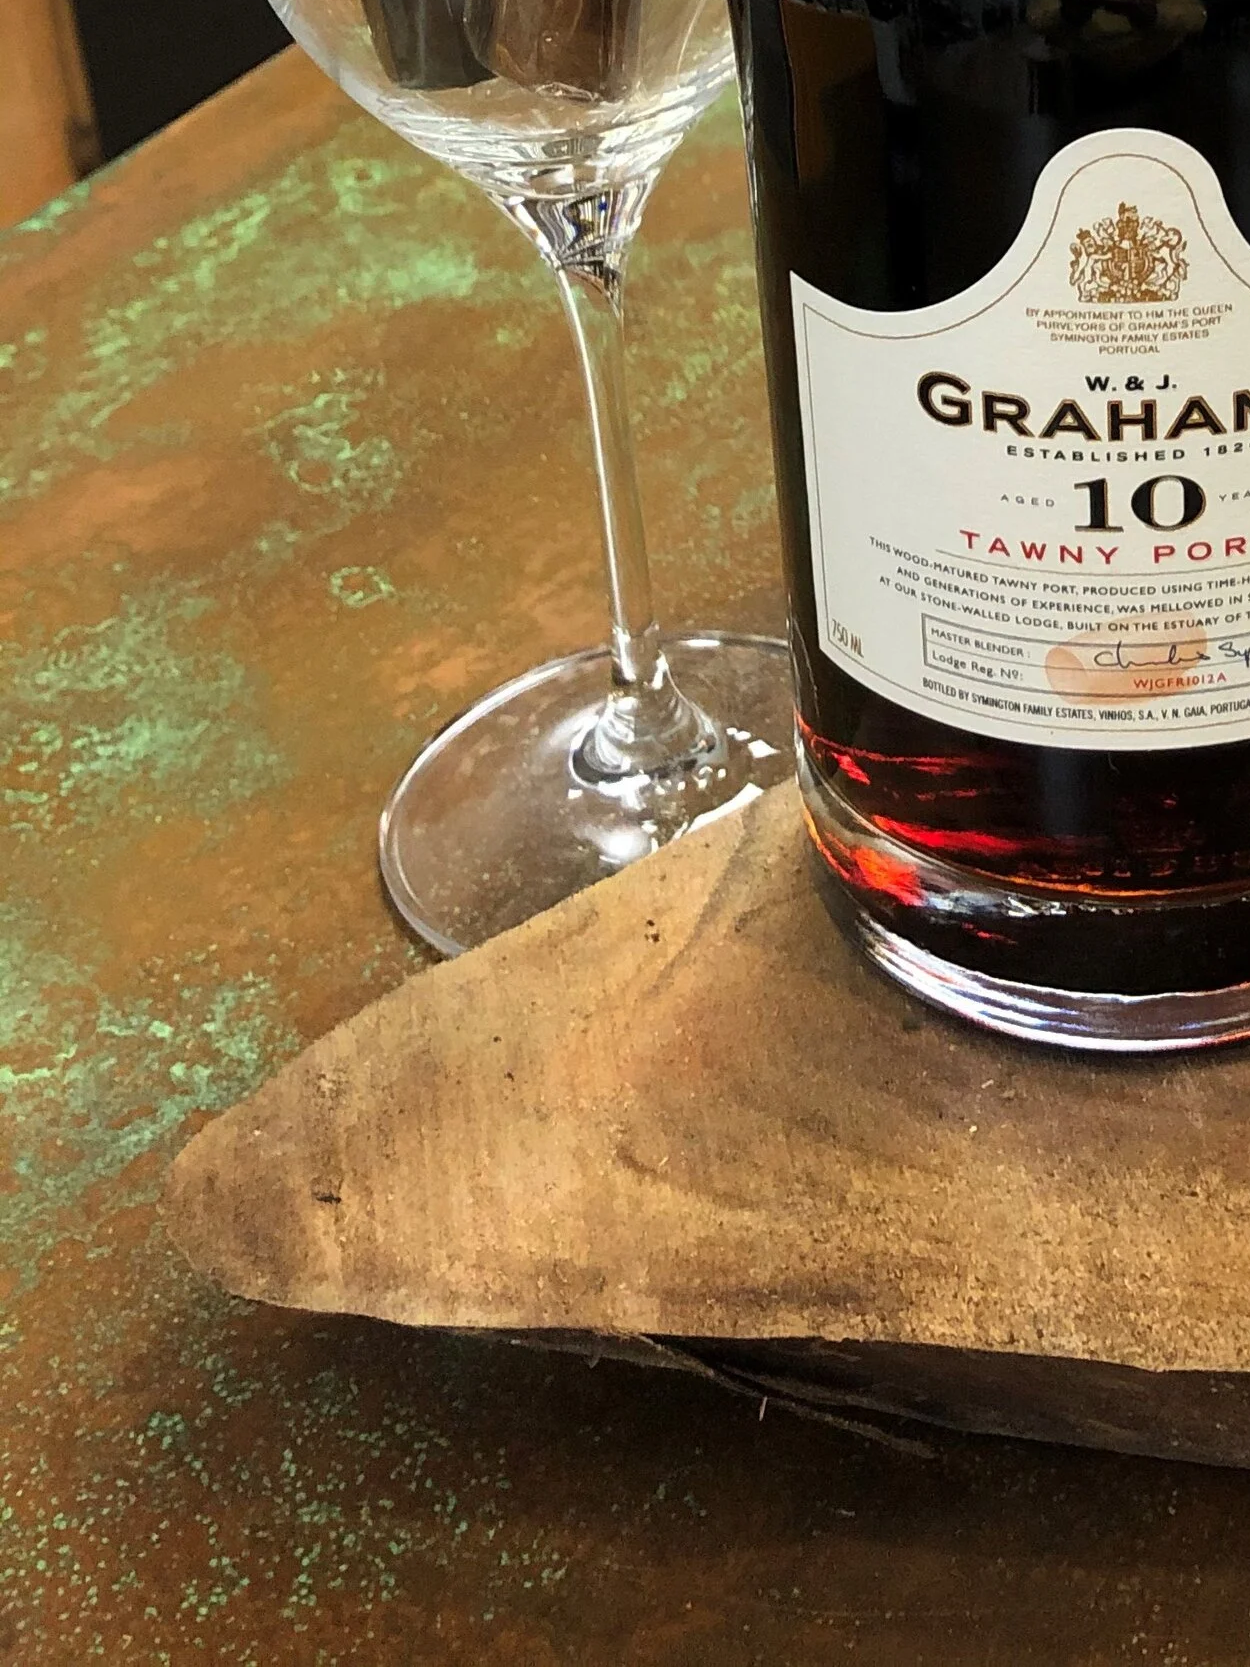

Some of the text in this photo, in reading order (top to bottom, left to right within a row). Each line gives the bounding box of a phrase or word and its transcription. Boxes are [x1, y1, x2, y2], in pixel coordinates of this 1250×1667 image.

[1025, 303, 1233, 321] BY APPOINTMENT TO HM THE QUEEN
[1036, 315, 1222, 332] PURVEYORS OF GRAHAM'S PORT
[1050, 328, 1210, 344] SYMINGTON FAMILY ESTATES
[1098, 344, 1161, 355] PORTUGAL
[1085, 373, 1178, 392] W. & J.
[1006, 445, 1187, 464] ESTABLISHED
[1000, 492, 1056, 508] AGED
[1073, 474, 1208, 534] 10
[959, 529, 1120, 566] TAWNY
[869, 536, 891, 554] THIS
[893, 546, 989, 584] WOOD-MATURED
[992, 575, 1038, 591] TAWNY
[1042, 583, 1079, 596] PORT,
[1082, 586, 1157, 597] PRODUCED
[1161, 581, 1203, 595] USING
[879, 575, 891, 588] AT
[894, 581, 917, 598] OUR
[920, 591, 1011, 623] STONE-WALLED
[1015, 615, 1064, 631] LODGE,
[1067, 621, 1101, 632] BUILT
[1107, 622, 1130, 632] ON
[1133, 620, 1159, 631] THE
[1163, 616, 1220, 631] ESTUARY
[1224, 612, 1242, 624] OF
[896, 565, 920, 582] AND
[923, 576, 1006, 606] GENERATIONS
[1010, 596, 1028, 608] OF
[1031, 599, 1115, 615] EXPERIENCE,
[1116, 604, 1146, 614] WAS
[1150, 597, 1224, 614] MELLOWED
[1228, 594, 1243, 606] IN
[831, 618, 865, 659] 750 ML
[930, 626, 972, 647] MASTER
[931, 649, 967, 671] Lodge
[970, 660, 997, 679] Reg.
[922, 677, 957, 699] BOTTLED
[958, 689, 970, 702] BY
[971, 693, 1022, 714] SYMINGTON
[1023, 702, 1053, 718] FAMILY
[1055, 708, 1097, 722] ESTATES,
[1098, 709, 1136, 723] VINHOS,
[1138, 709, 1159, 722] S.A.,
[1183, 705, 1208, 718] GAIA,
